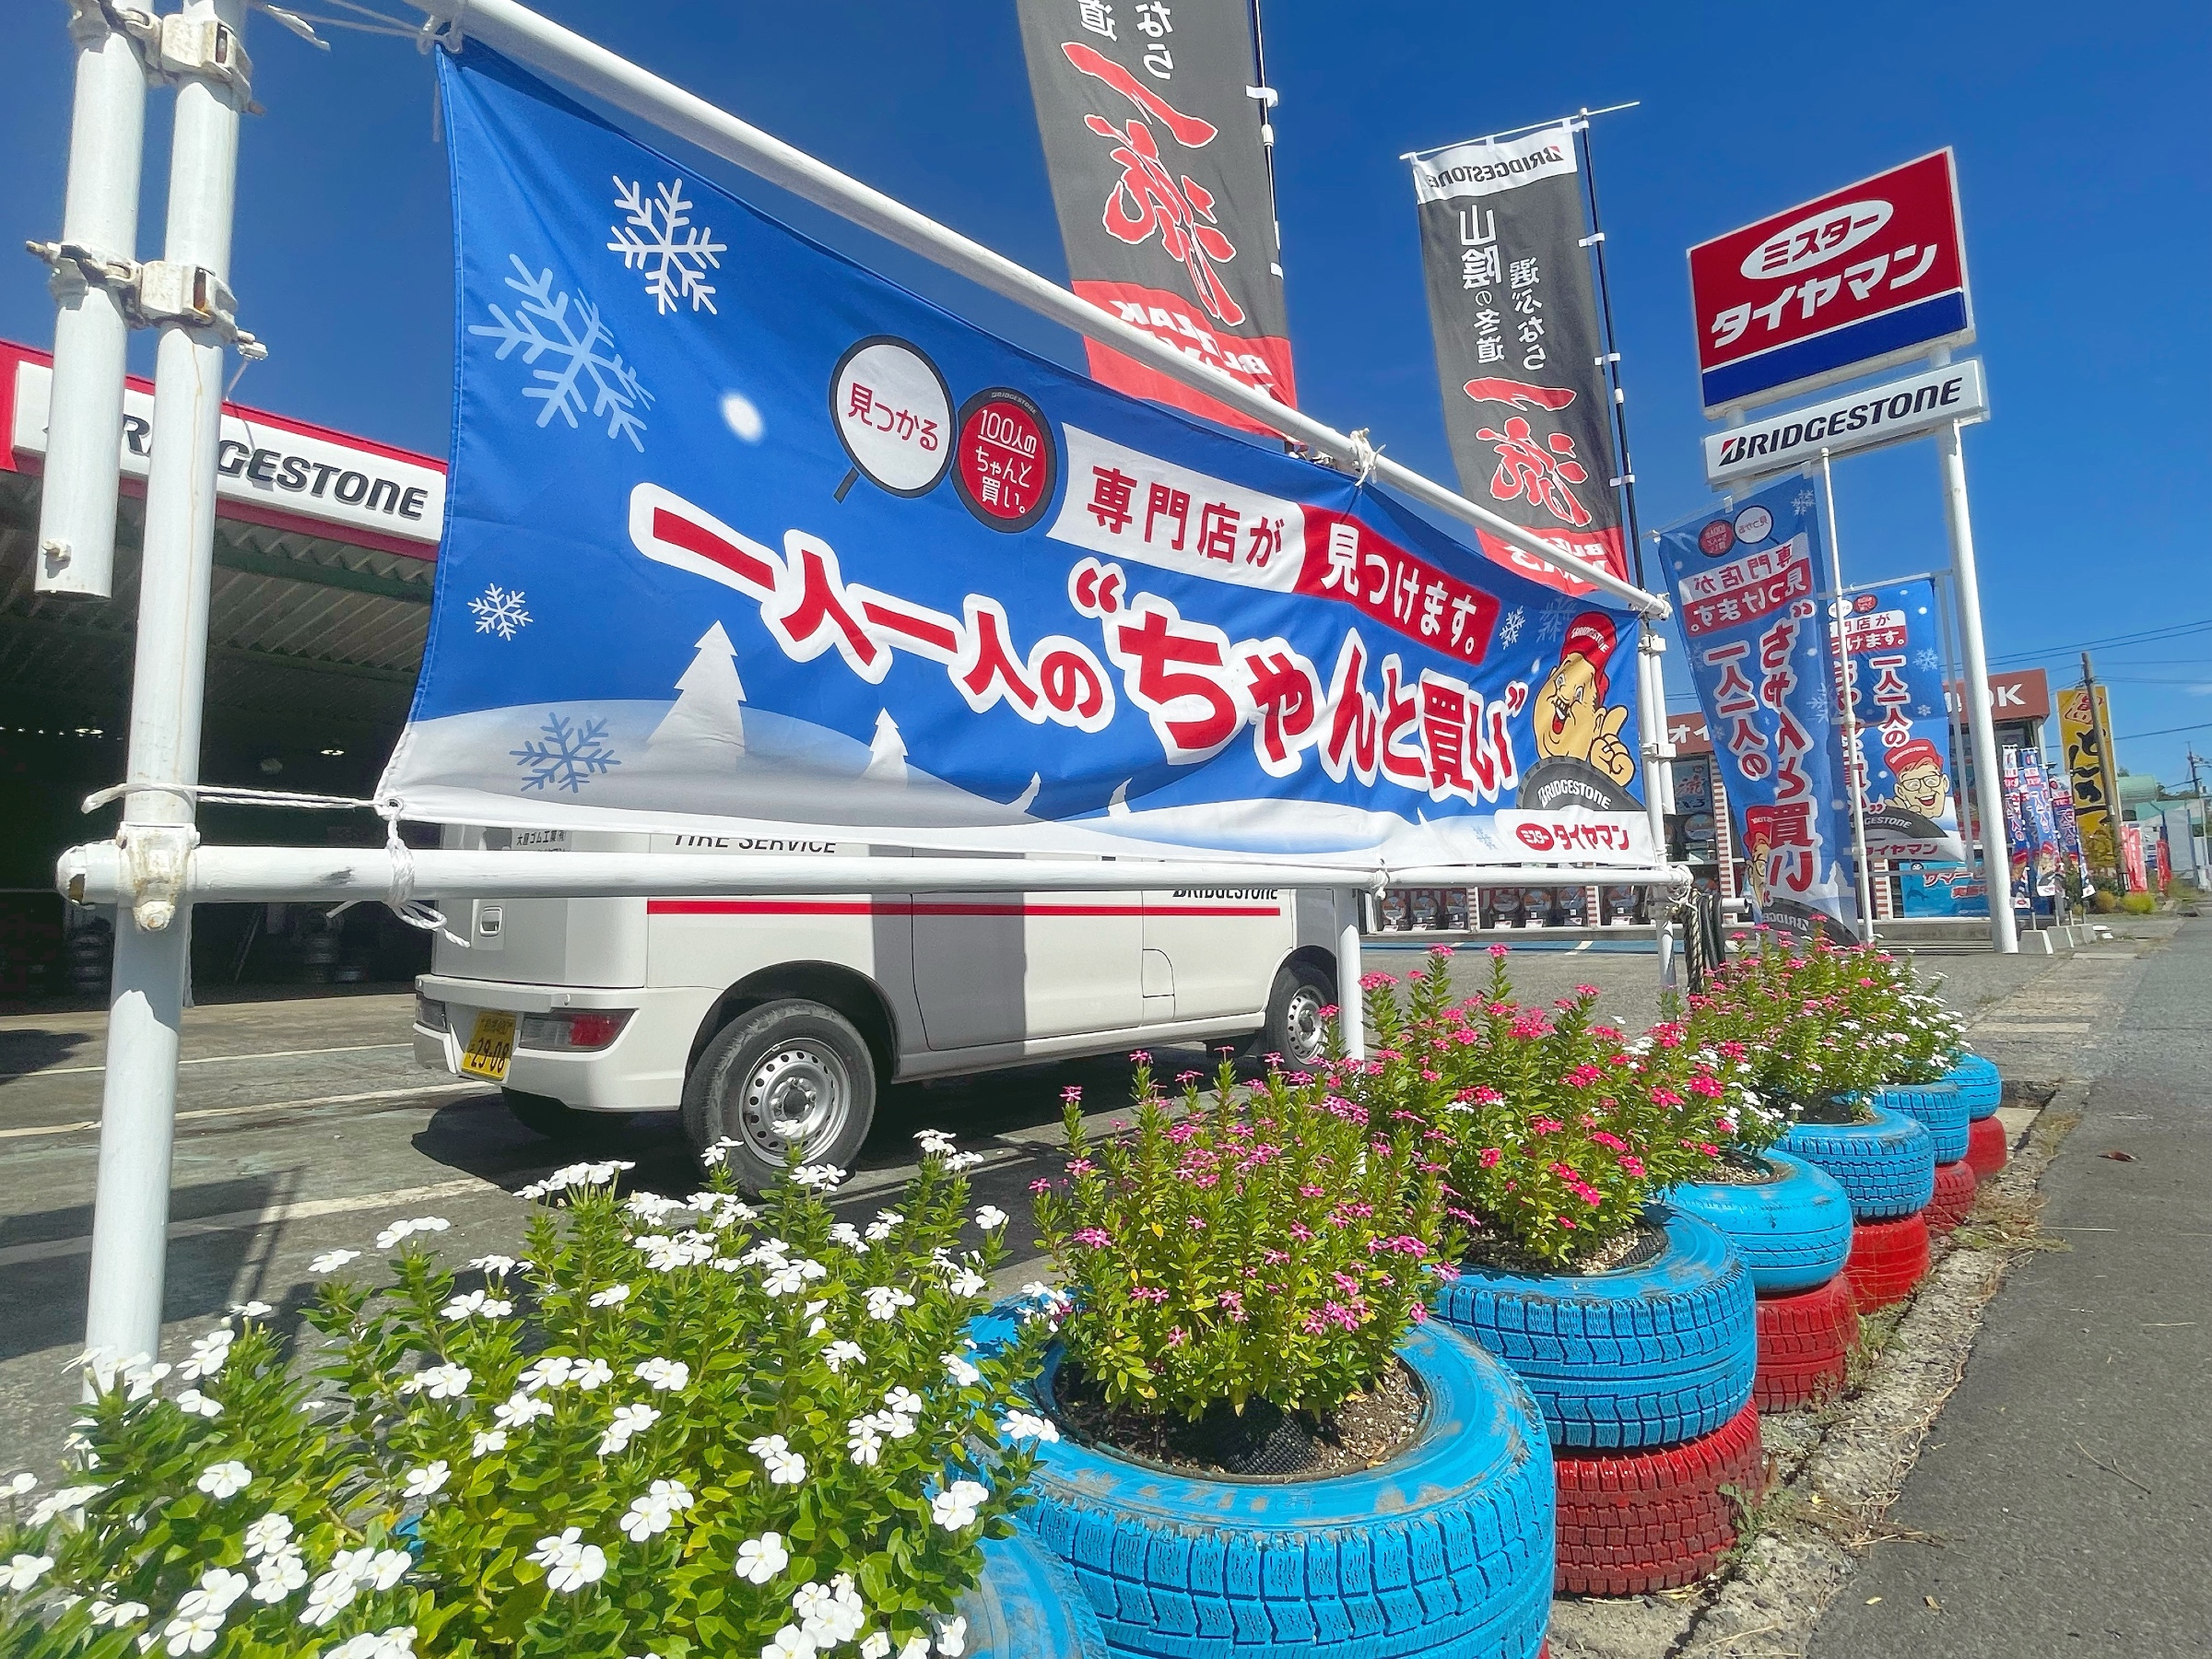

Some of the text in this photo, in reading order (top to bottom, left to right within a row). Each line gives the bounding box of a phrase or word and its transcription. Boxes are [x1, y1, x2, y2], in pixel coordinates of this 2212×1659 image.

[1761, 214, 1879, 272] ミスター
[1711, 243, 1937, 348] タイヤマン
[849, 382, 938, 451] 見つかる
[980, 409, 1038, 454] 100人の
[1718, 377, 1963, 465] BRIDGESTONE
[43, 412, 429, 520] RGESTONE
[975, 446, 1033, 488] ちゃんと
[982, 476, 1027, 514] 買い。
[1537, 779, 1613, 810] BRIDGESTONE
[1521, 824, 1630, 851] ミスター タイヤマン
